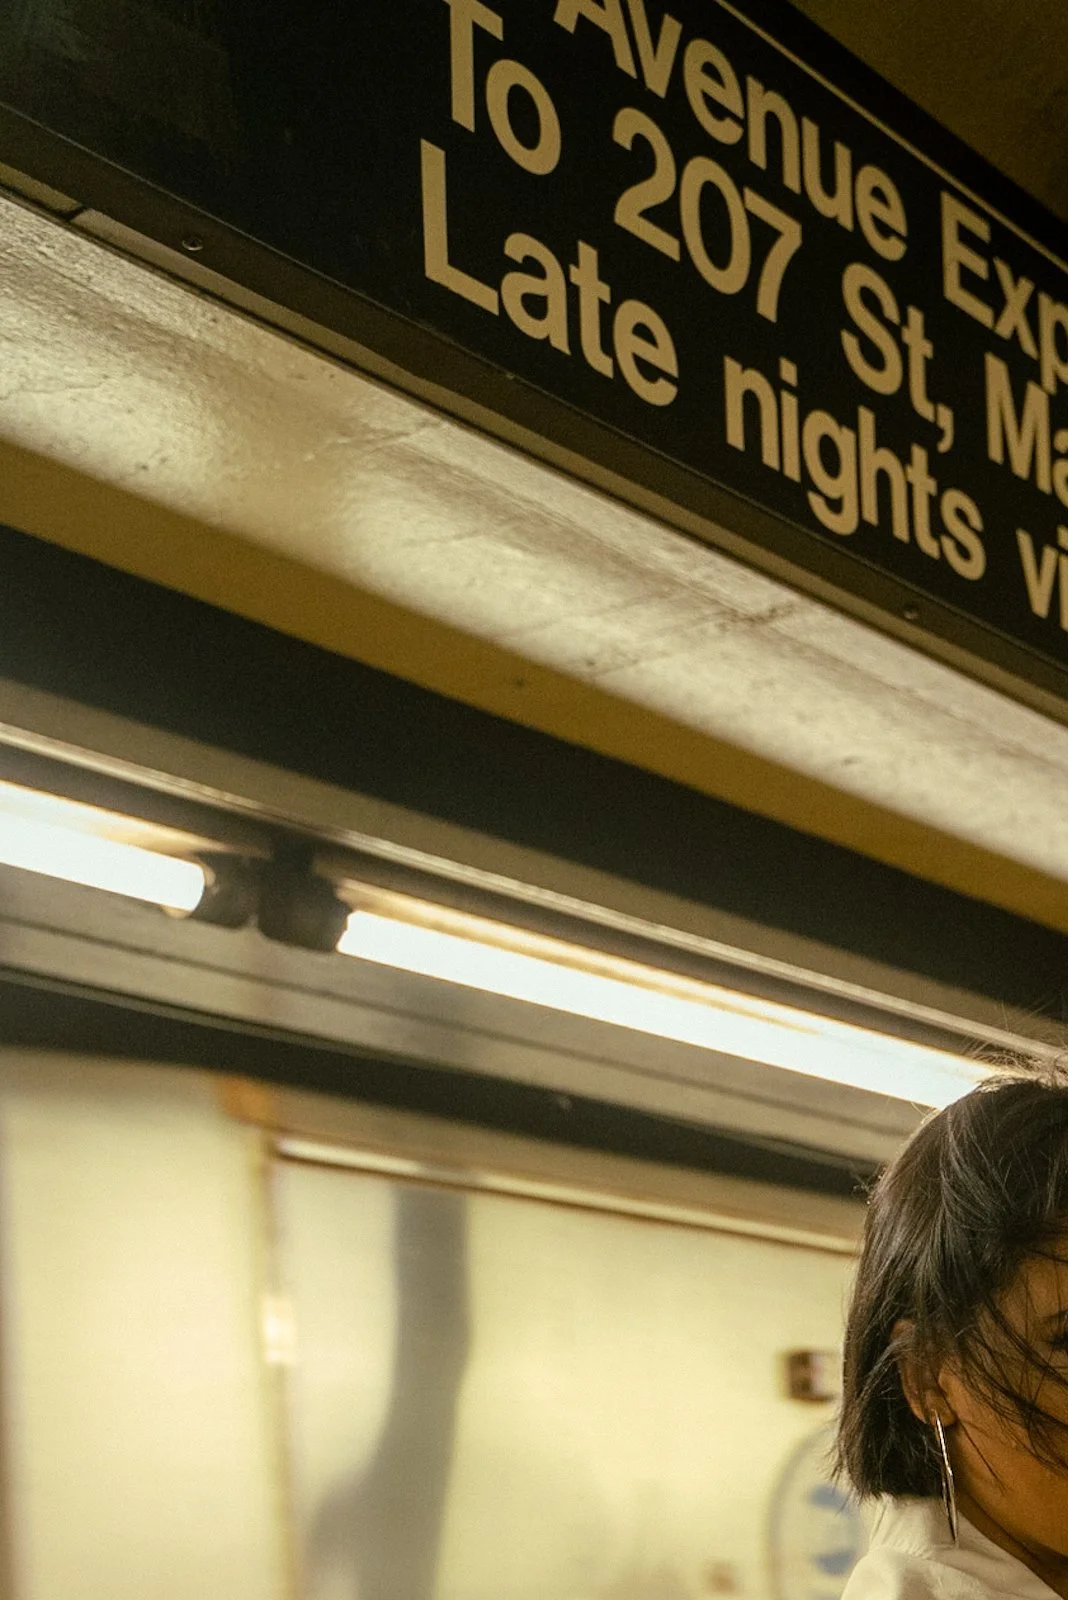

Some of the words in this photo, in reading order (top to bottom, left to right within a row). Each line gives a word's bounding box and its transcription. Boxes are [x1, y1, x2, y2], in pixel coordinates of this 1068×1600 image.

[420, 139, 680, 406] Late
[724, 356, 986, 580] nights
[444, 0, 562, 175] To
[613, 107, 802, 323] 207
[841, 263, 955, 454] St,
